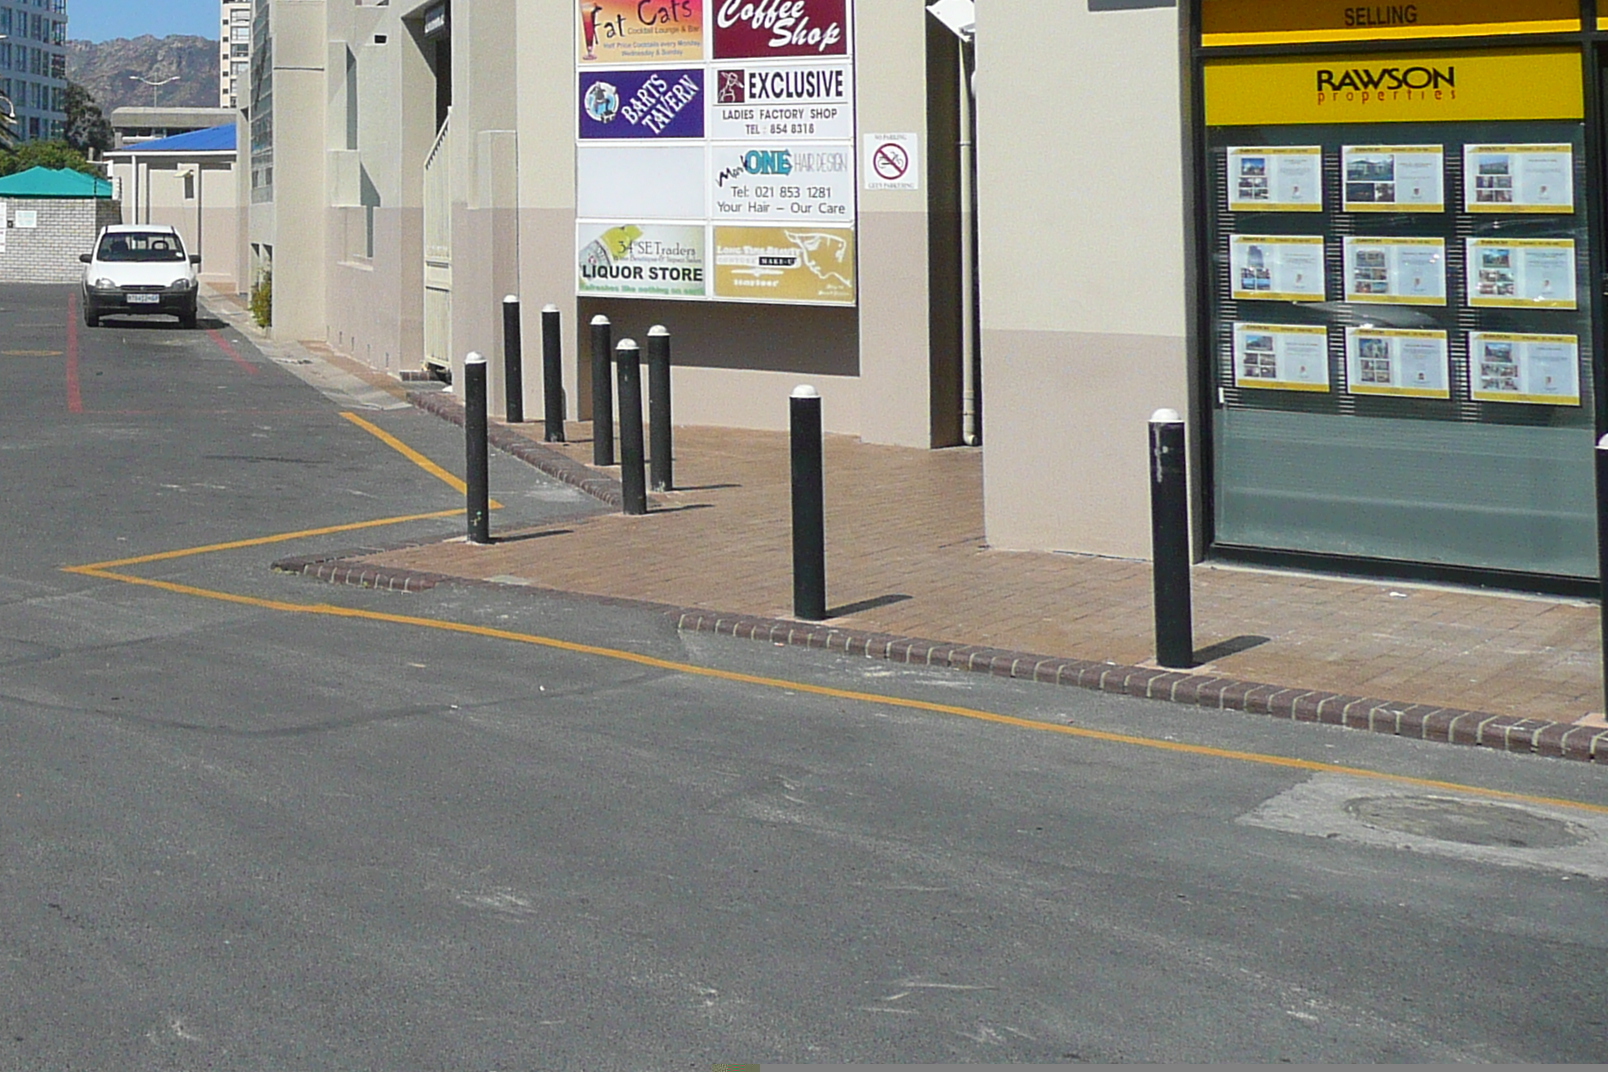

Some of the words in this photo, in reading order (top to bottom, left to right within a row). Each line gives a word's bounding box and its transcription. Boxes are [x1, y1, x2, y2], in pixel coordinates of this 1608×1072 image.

[590, 5, 627, 45] Fat
[1344, 4, 1417, 26] SELLING
[768, 17, 841, 51] Shop
[748, 70, 844, 99] EXCLUSIVE
[1316, 66, 1455, 91] RAWSON
[621, 73, 668, 126] BARTS
[641, 74, 700, 135] TAVERN
[1317, 88, 1456, 105] properties
[722, 109, 755, 121] LADIES
[759, 108, 804, 121] FACTORY
[810, 108, 838, 120] SHOP
[745, 149, 793, 176] ONE
[731, 186, 749, 198] Tel:
[755, 186, 774, 198] 021
[779, 186, 800, 198] 853
[806, 186, 831, 198] 1281
[717, 201, 742, 213] Your
[748, 201, 770, 213] Hair
[790, 202, 812, 214] Our
[818, 202, 846, 215] Care
[582, 265, 643, 279] LIQUOR
[649, 266, 703, 282] STORE
